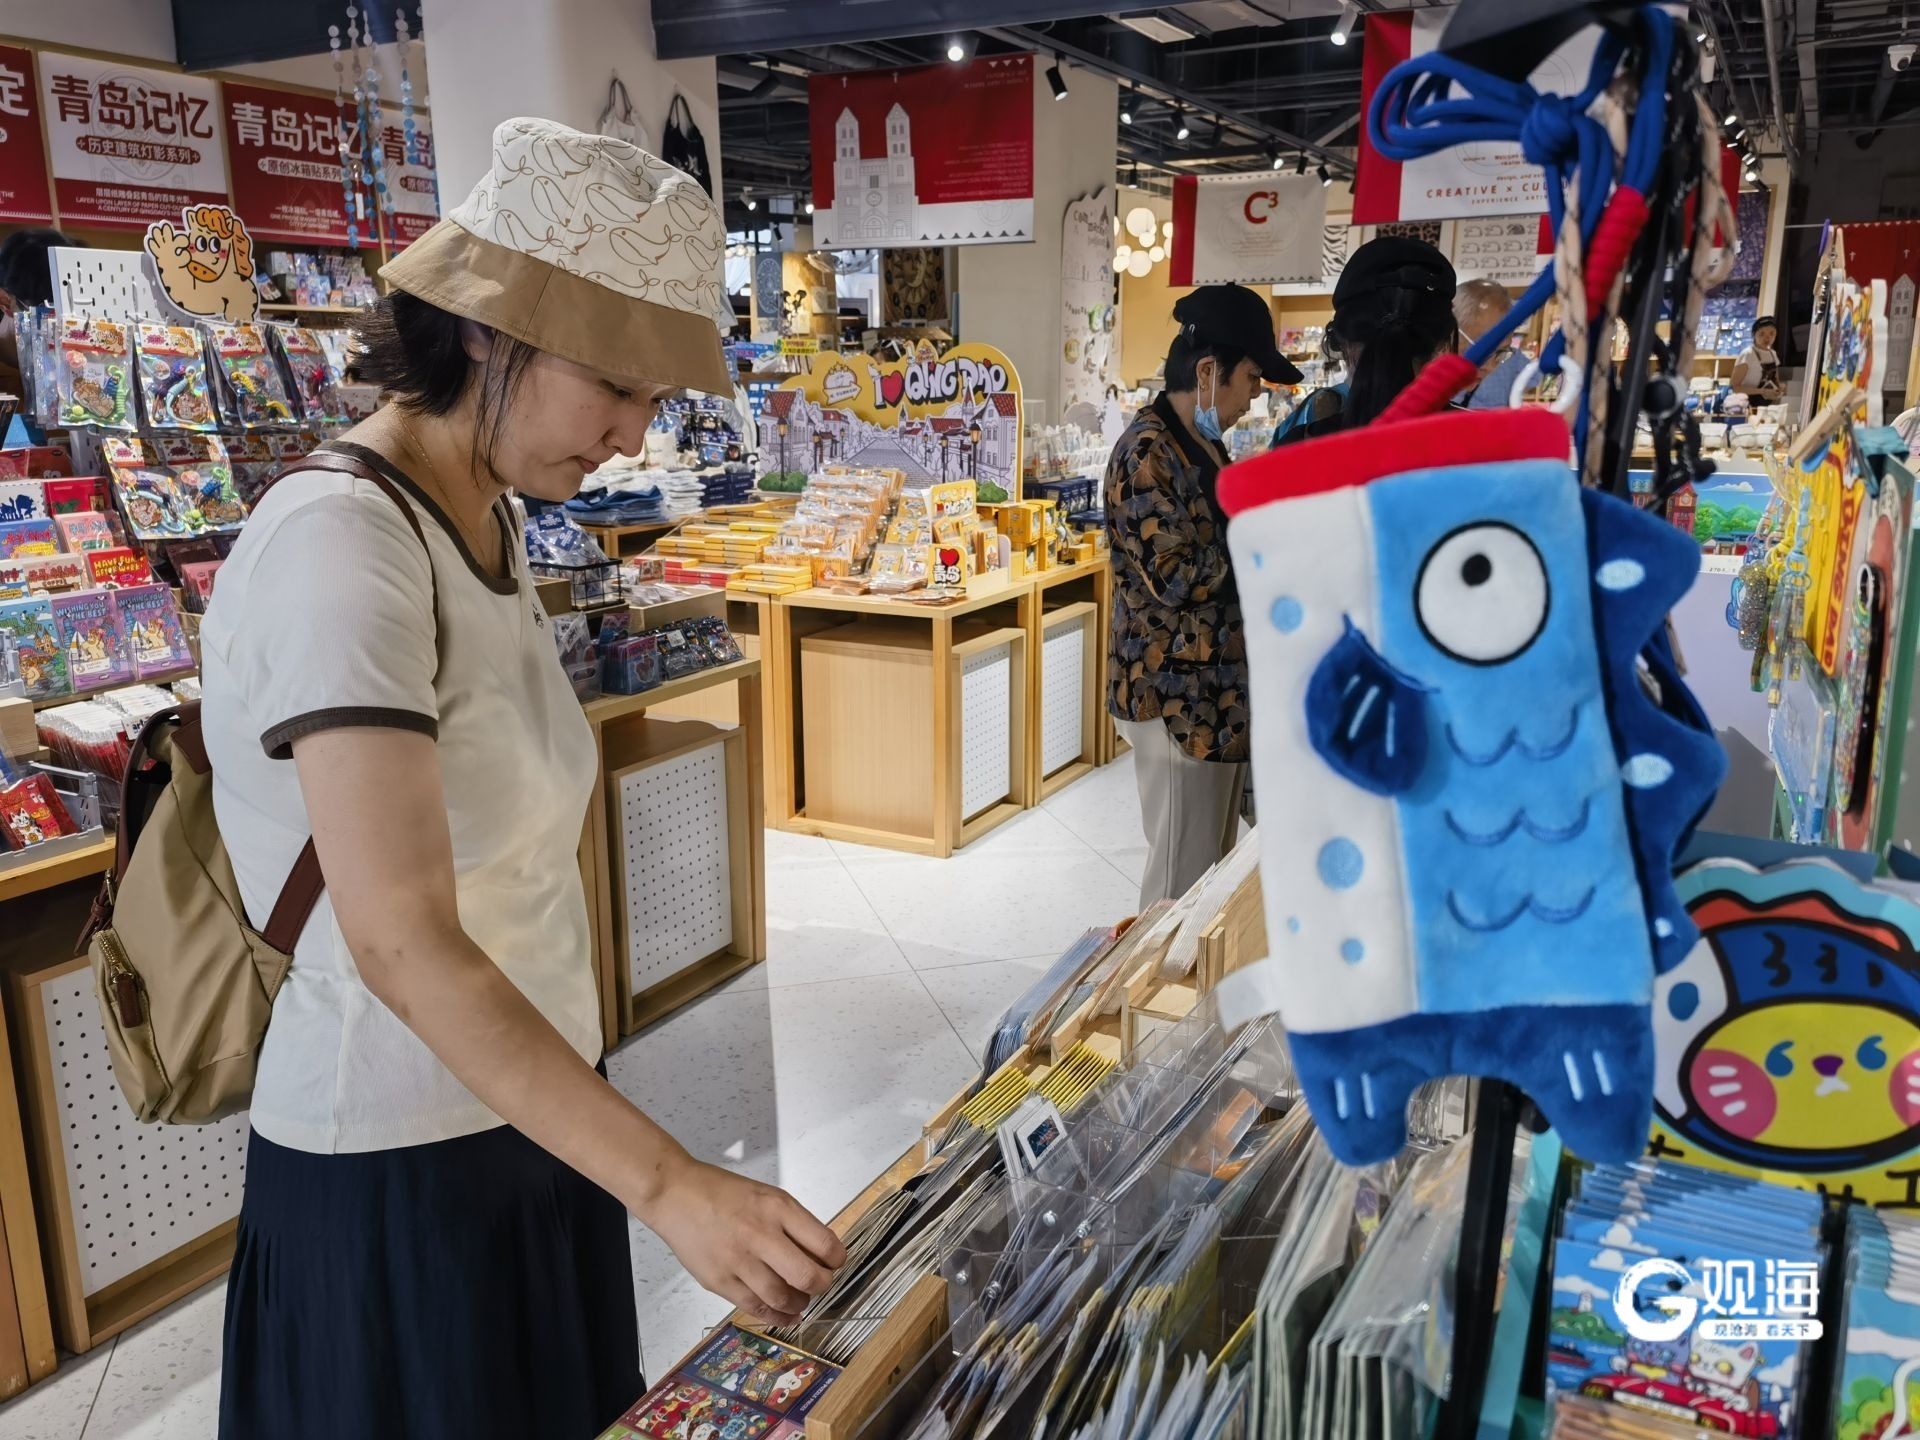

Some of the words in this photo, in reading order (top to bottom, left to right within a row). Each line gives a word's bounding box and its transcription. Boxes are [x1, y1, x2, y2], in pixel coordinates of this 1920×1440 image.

[51, 74, 214, 139] 青岛记忆
[231, 102, 366, 160] 青岛记忆
[88, 137, 192, 164] 历史建筑灯影系列
[267, 159, 343, 182] 原创冰箱贴系列
[1426, 185, 1498, 199] CREATIVE
[904, 359, 957, 403] QING
[957, 356, 1009, 397] DAO
[933, 563, 962, 585] 青岛
[131, 602, 147, 612] THE
[147, 598, 165, 610] BEST
[150, 592, 164, 603] YOU
[56, 603, 88, 617] WISHING
[89, 601, 105, 612] YOU
[70, 612, 87, 621] THE
[88, 608, 106, 620] BEST
